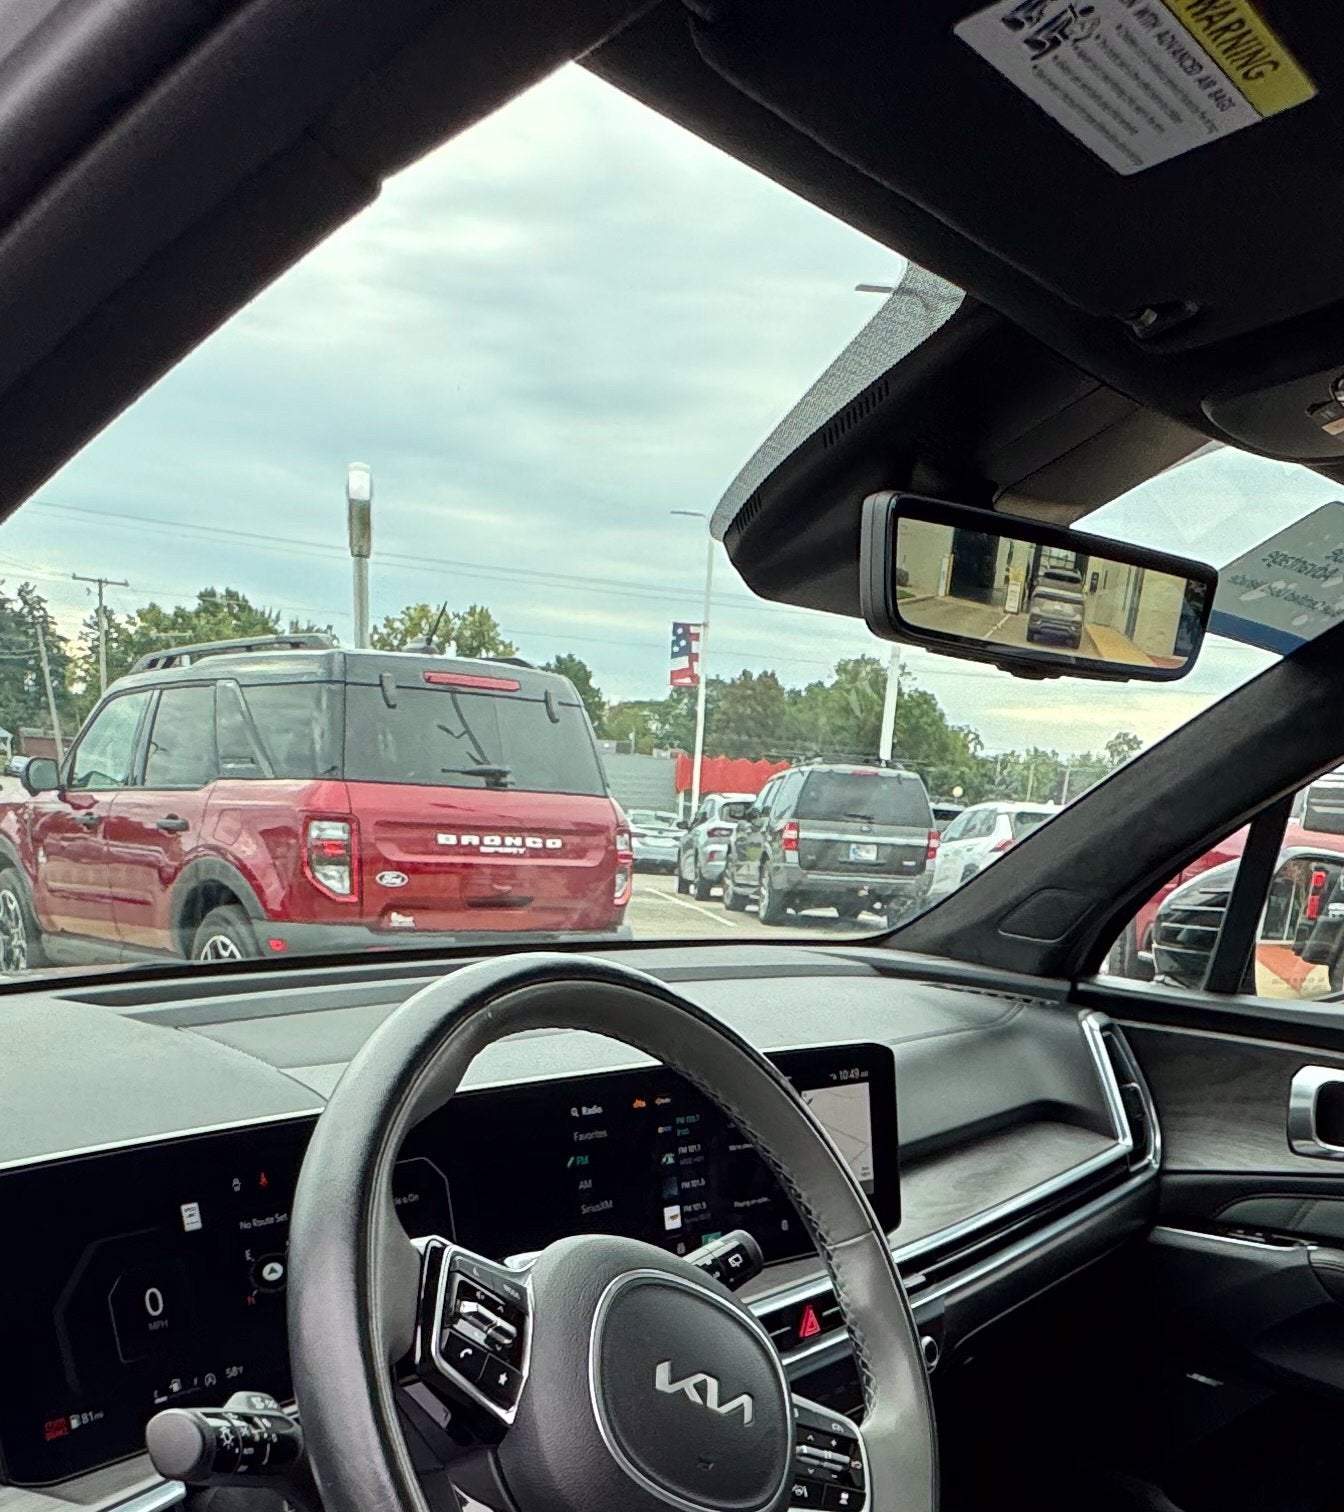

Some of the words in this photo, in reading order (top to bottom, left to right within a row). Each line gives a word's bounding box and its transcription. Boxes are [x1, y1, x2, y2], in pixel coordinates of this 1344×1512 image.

[1184, 0, 1280, 81] WARNING
[1156, 30, 1204, 77] ADVANCED
[1208, 88, 1236, 113] BAGS
[436, 832, 563, 849] BRONCO
[581, 1104, 603, 1116] Radio
[573, 1129, 608, 1142] Favorites
[239, 1221, 252, 1231] No
[252, 1215, 275, 1227] Route
[144, 1287, 164, 1317] 0
[148, 1319, 169, 1332] MPH
[655, 1360, 754, 1427] KIA
